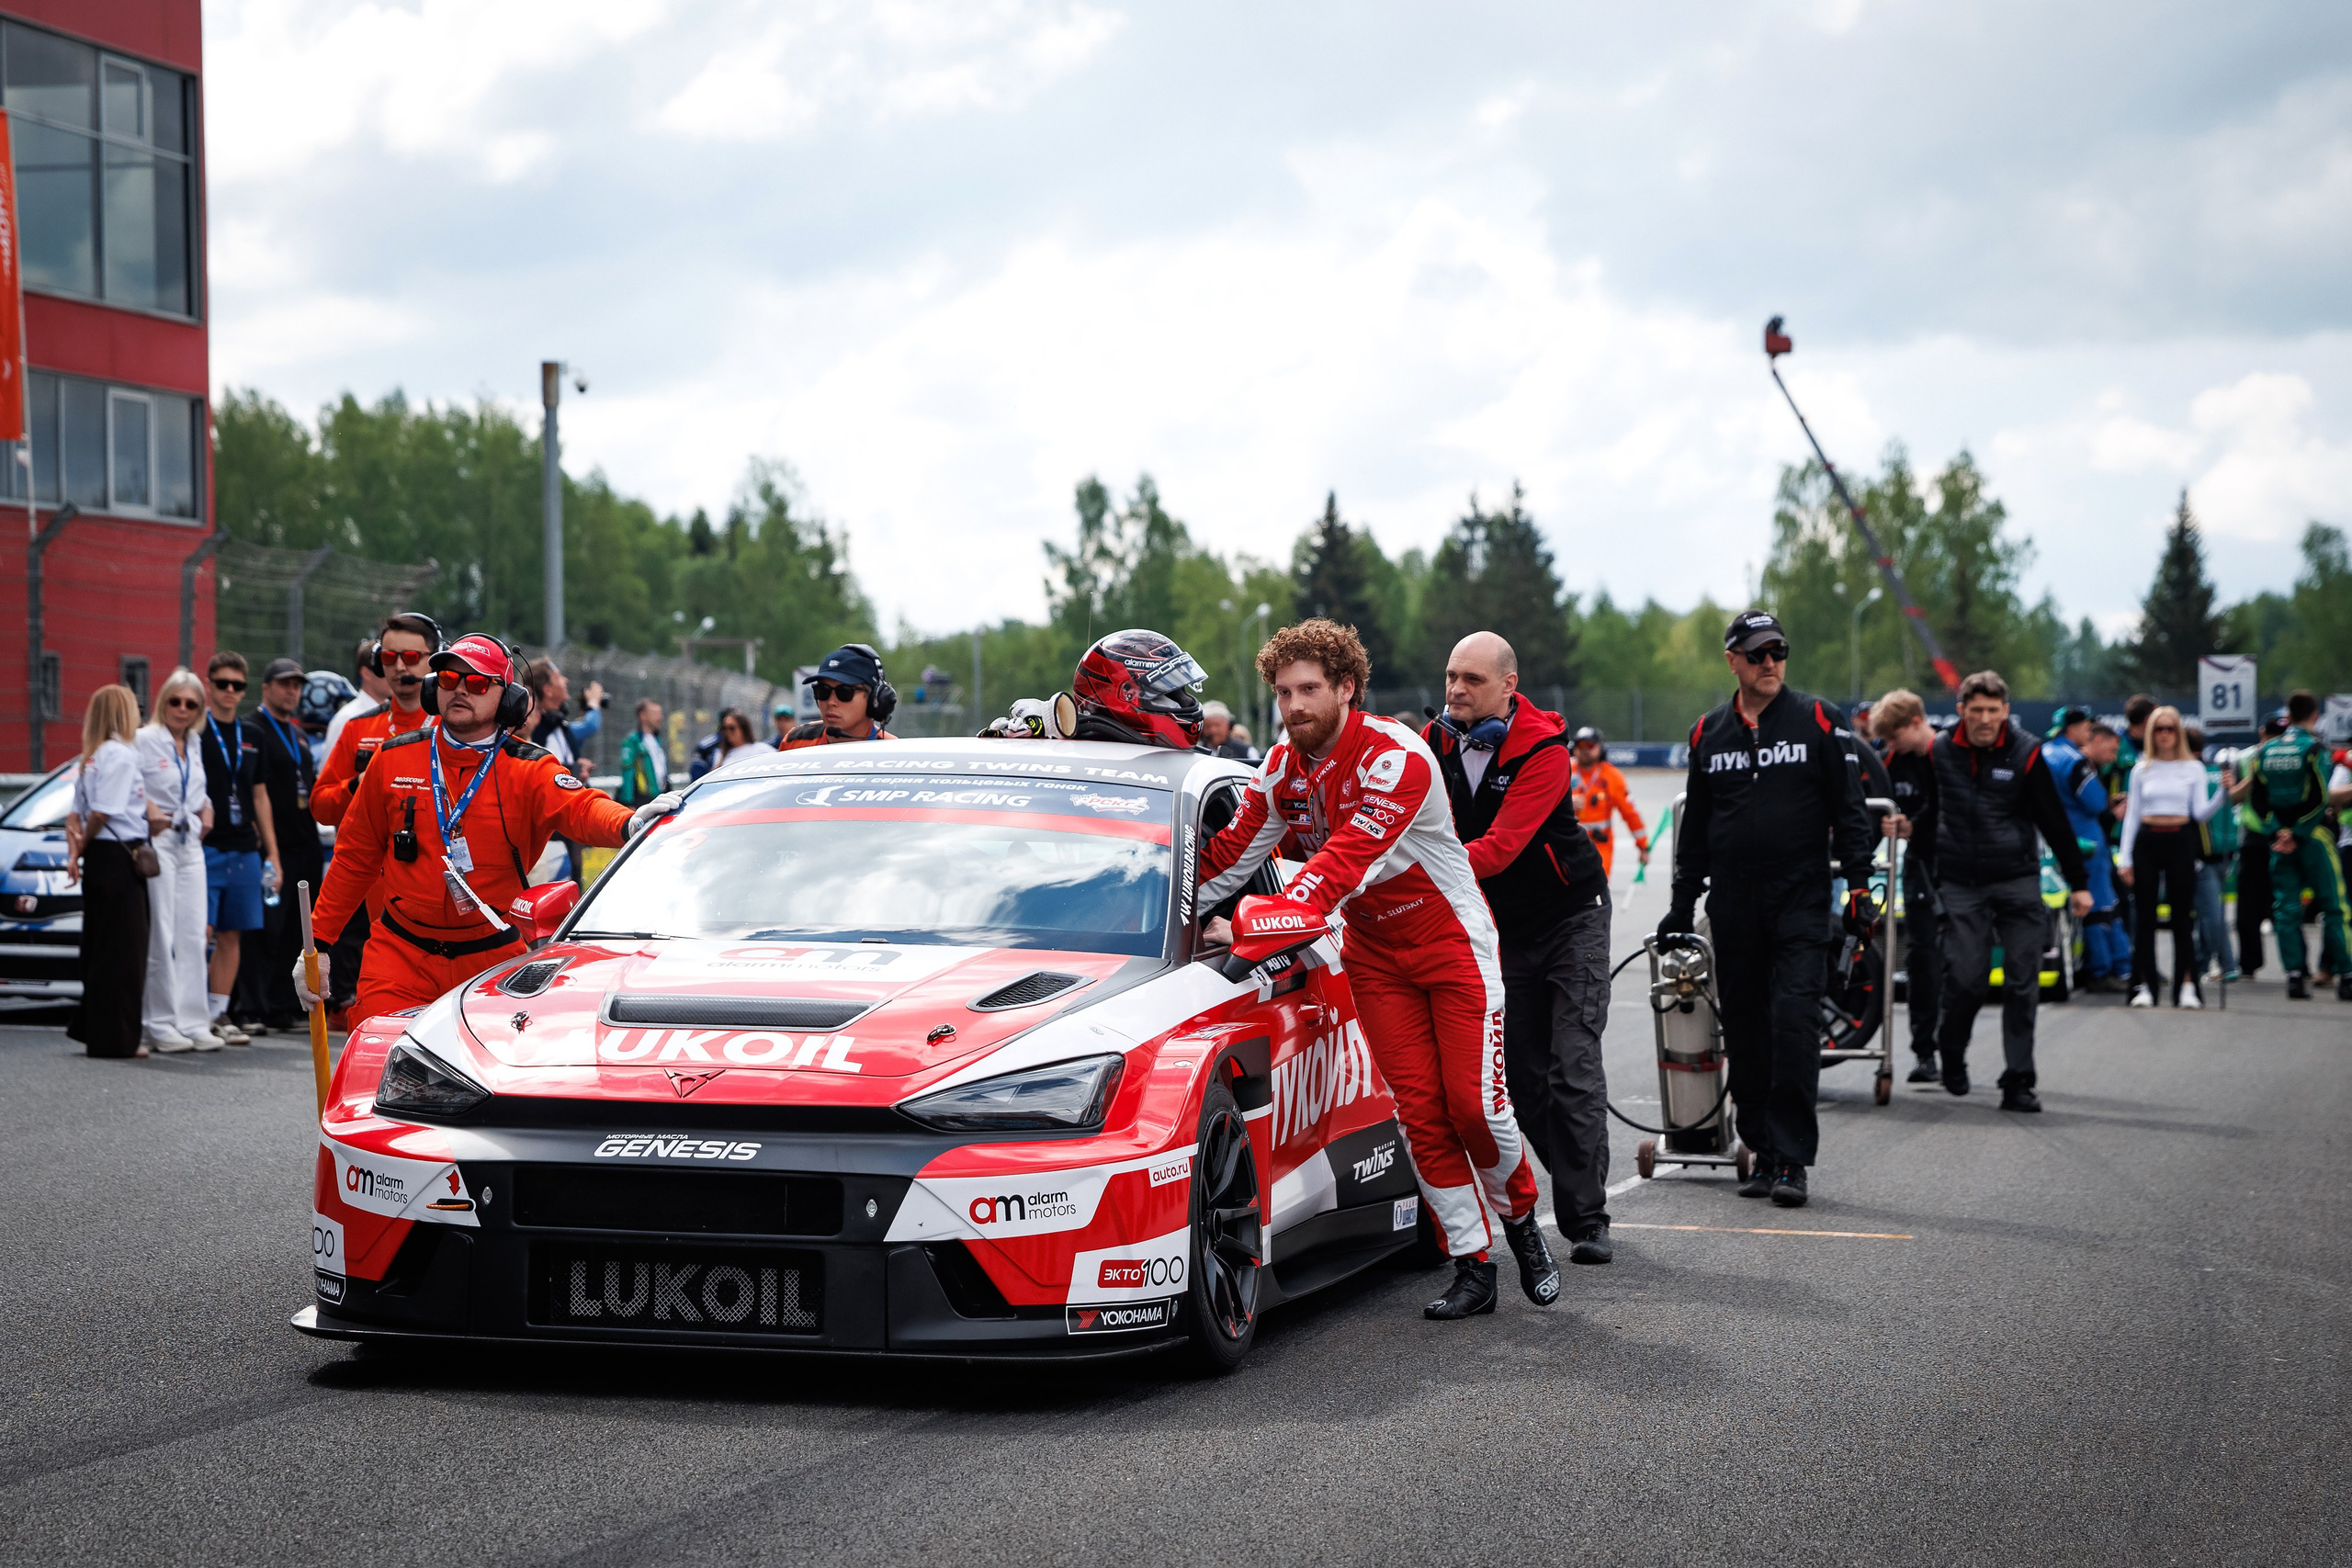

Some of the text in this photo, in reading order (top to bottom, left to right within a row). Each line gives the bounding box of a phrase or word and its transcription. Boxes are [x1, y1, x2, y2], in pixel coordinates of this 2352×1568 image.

[1146, 651, 1193, 682] PORS
[2211, 683, 2242, 710] 81
[1709, 740, 1807, 773] ЛУКОЙЛ
[717, 760, 1169, 784] LUKOIL RACING TWINS TEAM
[1316, 759, 1338, 783] LUKOIL
[928, 777, 1030, 788] кольцевых
[1035, 782, 1089, 792] гонок
[837, 789, 1033, 807] SMP RACING
[1363, 795, 1407, 815] GENESIS
[1352, 816, 1382, 836] TWINS
[1372, 807, 1396, 825] 100
[1287, 872, 1325, 903] OIL
[512, 897, 534, 914] LUKOIL
[1251, 915, 1306, 931] LUKOIL
[718, 946, 902, 965] am
[1488, 1010, 1505, 1116] ЛУКОЙЛ
[1272, 1006, 1372, 1151] ЛУКОЙЛ
[594, 1139, 763, 1161] GENESIS
[1152, 1161, 1189, 1183] auto.ru
[1352, 1146, 1396, 1181] TWINS
[346, 1164, 375, 1197] am
[376, 1173, 403, 1190] alarm
[375, 1187, 408, 1204] motors
[1027, 1190, 1069, 1206] alarm
[969, 1194, 1026, 1224] am
[1028, 1202, 1077, 1220] motors
[312, 1226, 334, 1258] 00
[1140, 1255, 1184, 1288] 100
[569, 1259, 817, 1328] LUKOIL
[1100, 1305, 1163, 1325] YOKOHAMA
